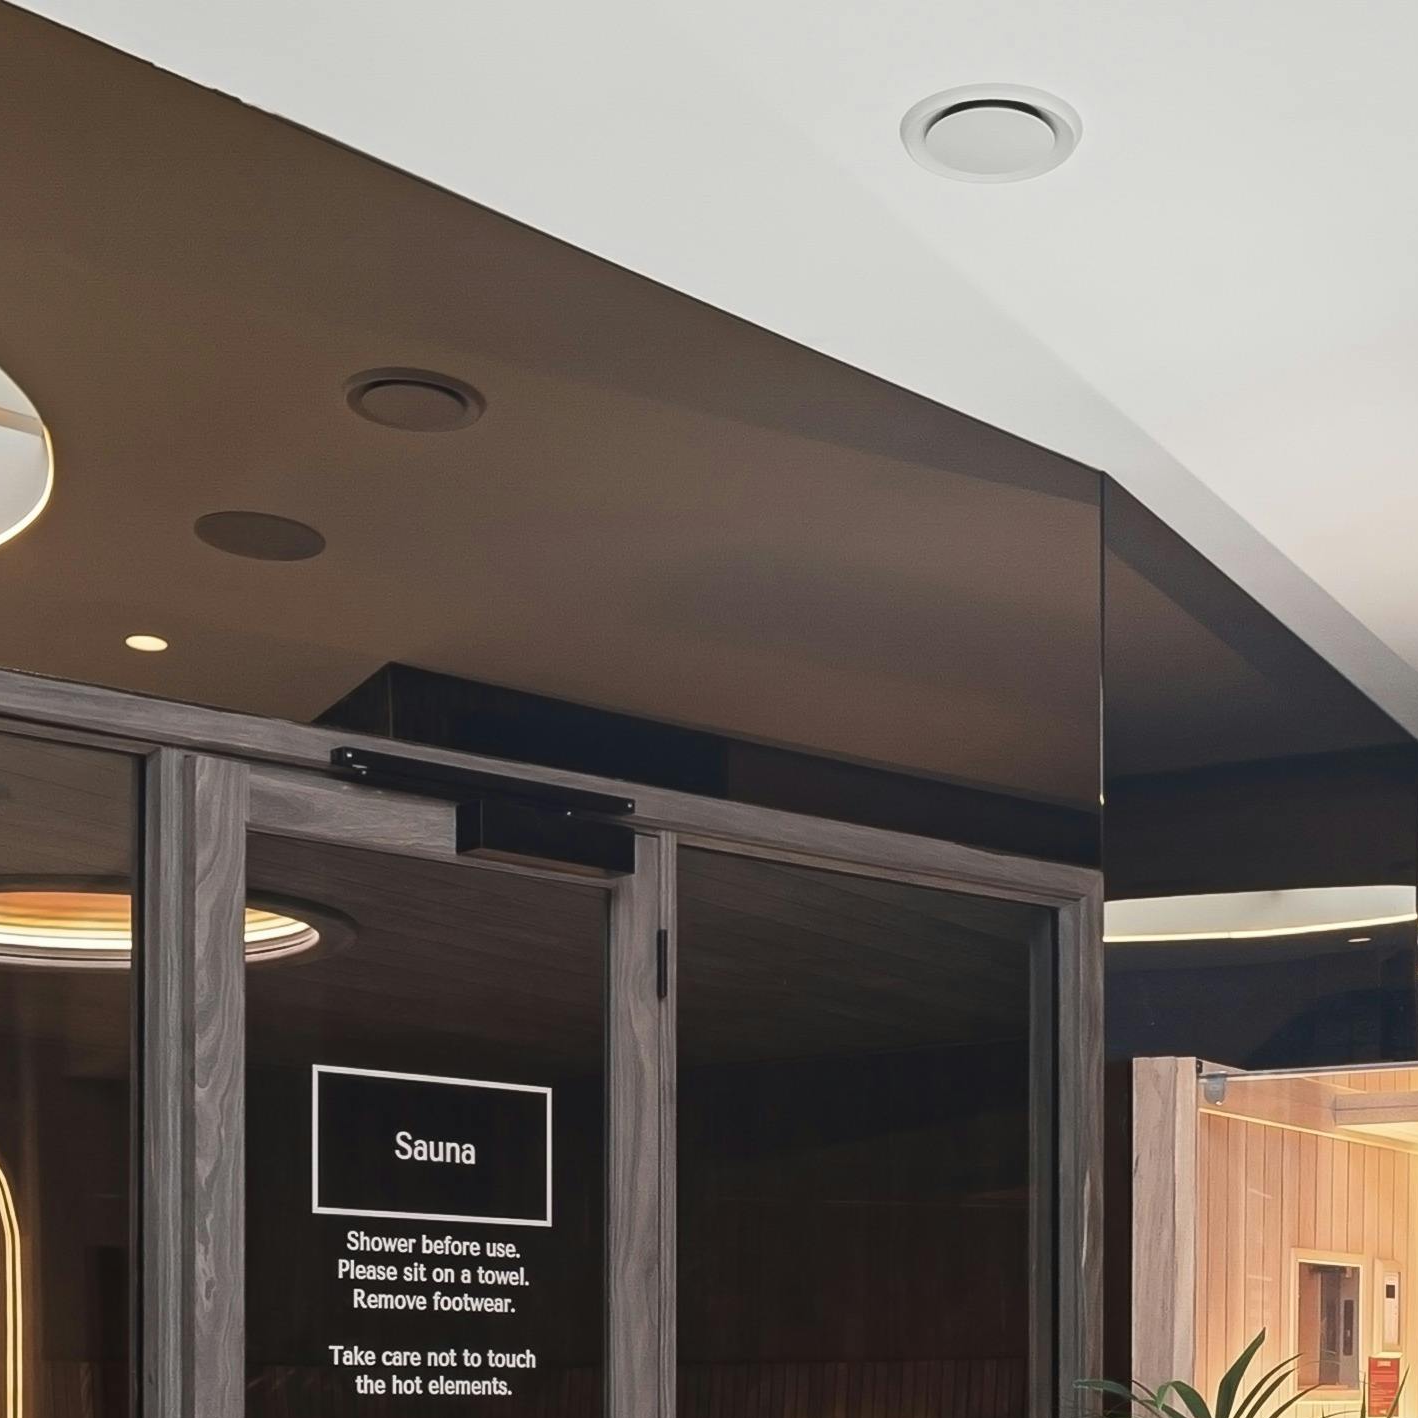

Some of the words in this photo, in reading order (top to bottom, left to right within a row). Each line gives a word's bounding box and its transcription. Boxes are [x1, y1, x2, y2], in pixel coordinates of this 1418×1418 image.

[394, 1130, 476, 1165] Sauna
[346, 1230, 417, 1254] Shower
[421, 1234, 481, 1257] before
[485, 1242, 521, 1259] use.
[337, 1258, 398, 1281] Please
[402, 1262, 428, 1282] sit
[431, 1267, 455, 1284] on
[460, 1268, 472, 1284] a
[476, 1265, 530, 1287] towel.
[353, 1288, 428, 1311] Remove
[432, 1290, 516, 1314] footwear.
[328, 1344, 377, 1366] Take
[381, 1350, 422, 1367] care
[427, 1348, 458, 1367] not
[462, 1348, 482, 1368] to
[486, 1348, 537, 1369] touch
[354, 1374, 387, 1395] the
[391, 1374, 424, 1395] hot
[427, 1375, 513, 1396] elements.
